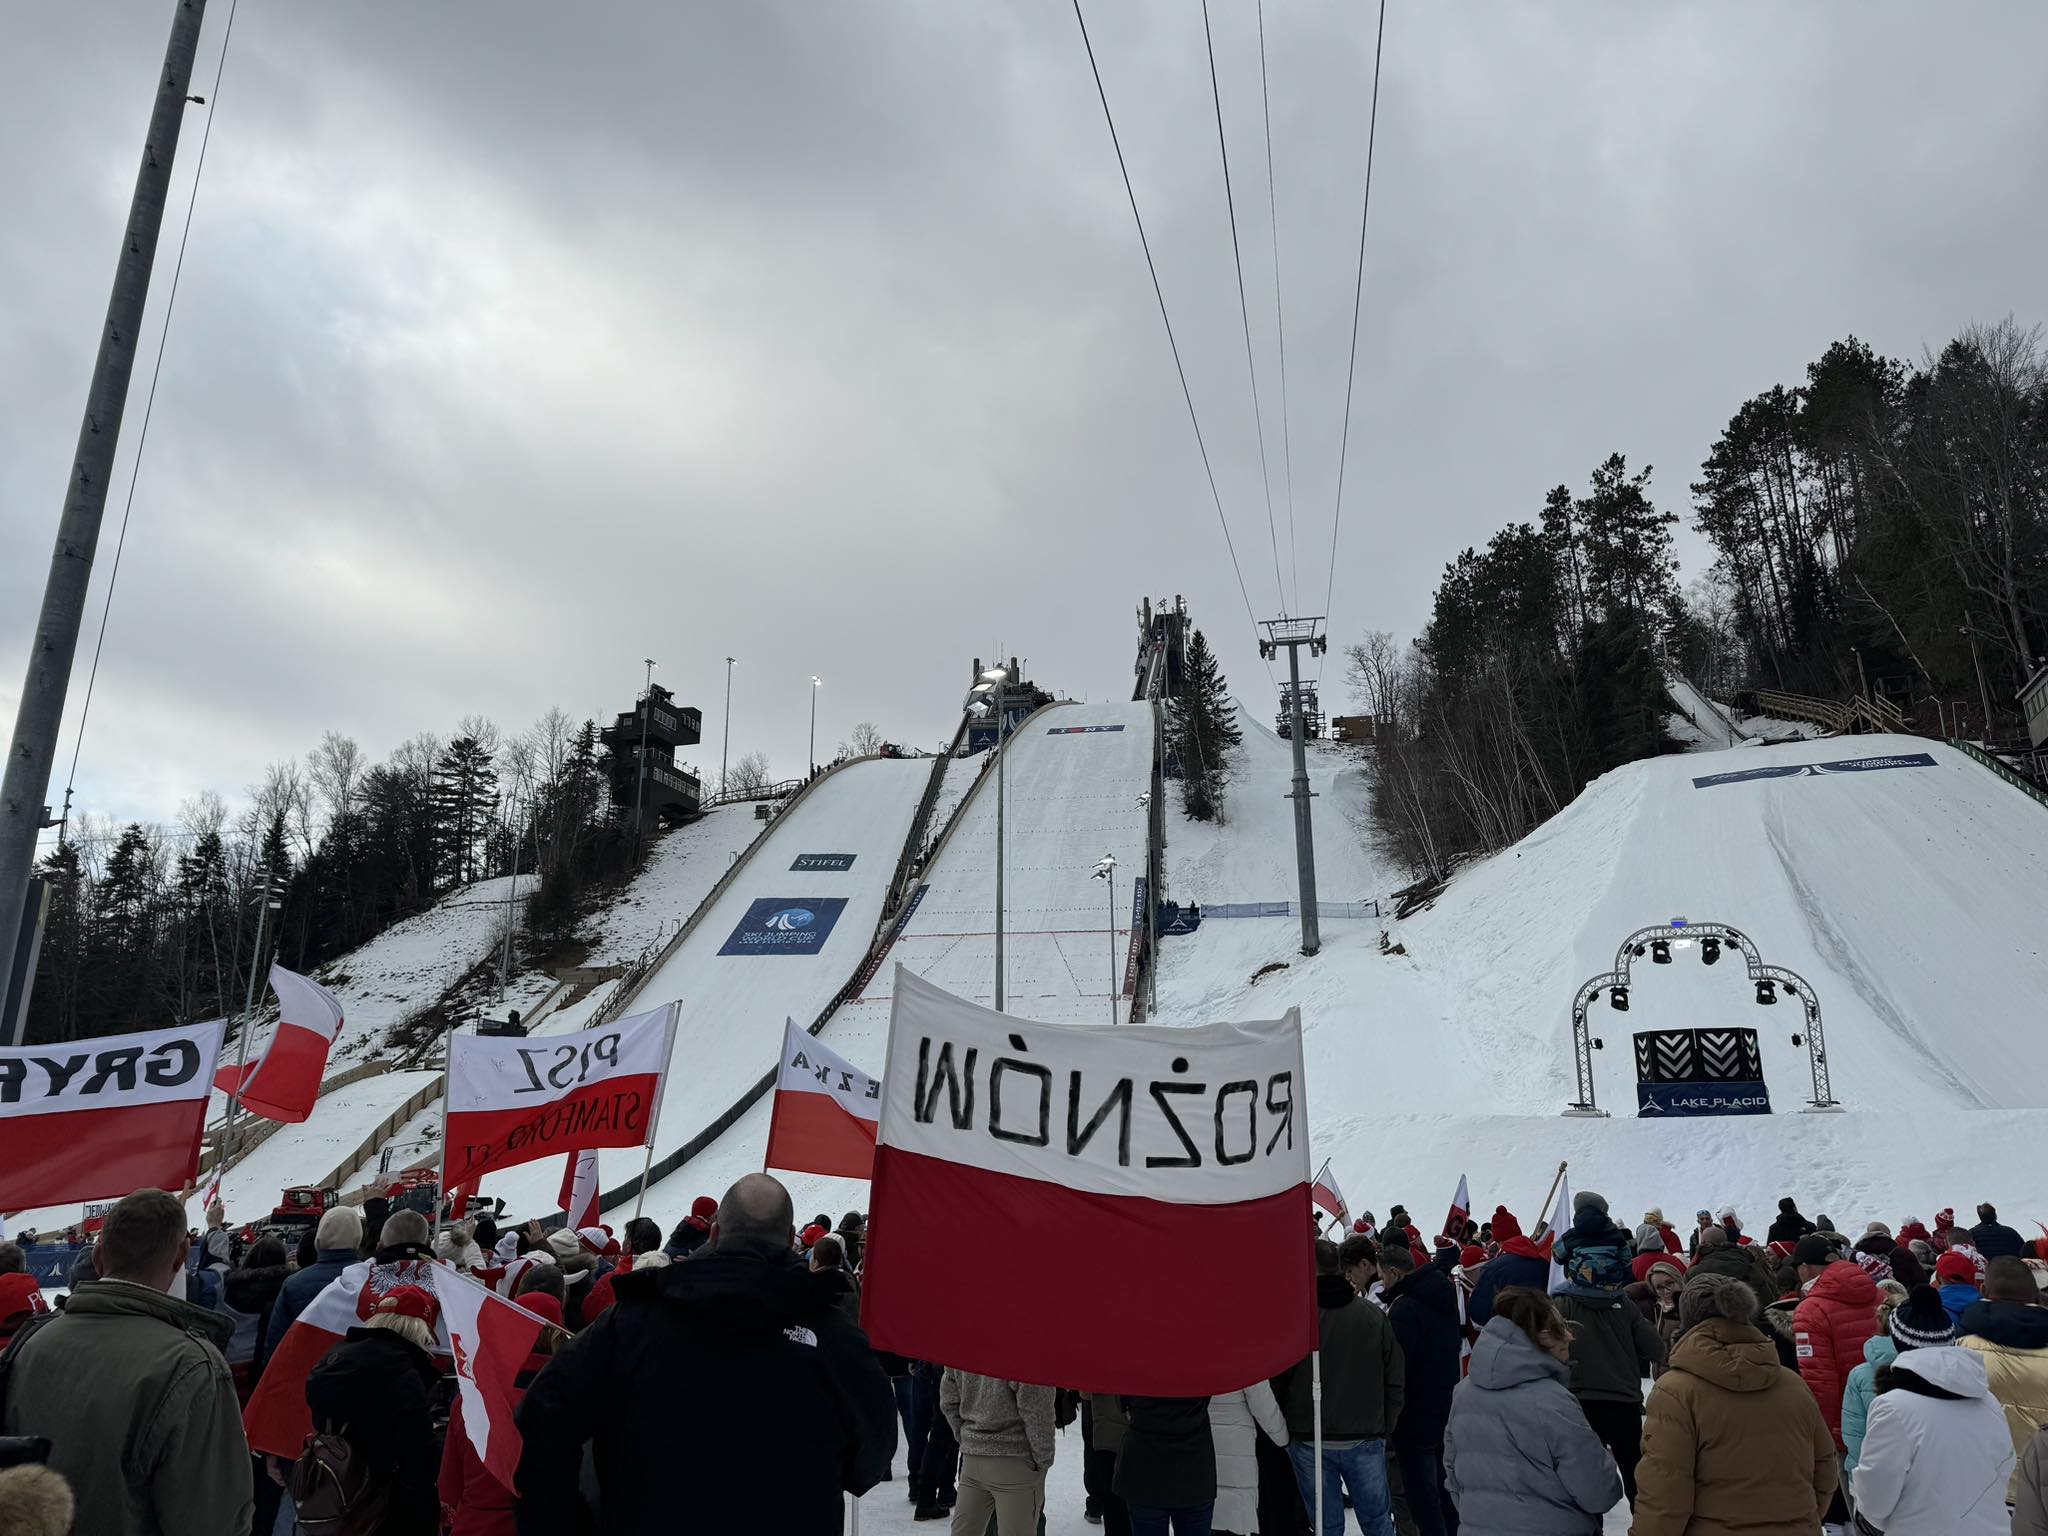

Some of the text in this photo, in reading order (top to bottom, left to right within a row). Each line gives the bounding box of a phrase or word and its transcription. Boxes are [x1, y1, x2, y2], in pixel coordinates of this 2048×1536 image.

[798, 859, 846, 867] STIFEL
[1671, 1096, 1767, 1107] LAKE PLACID
